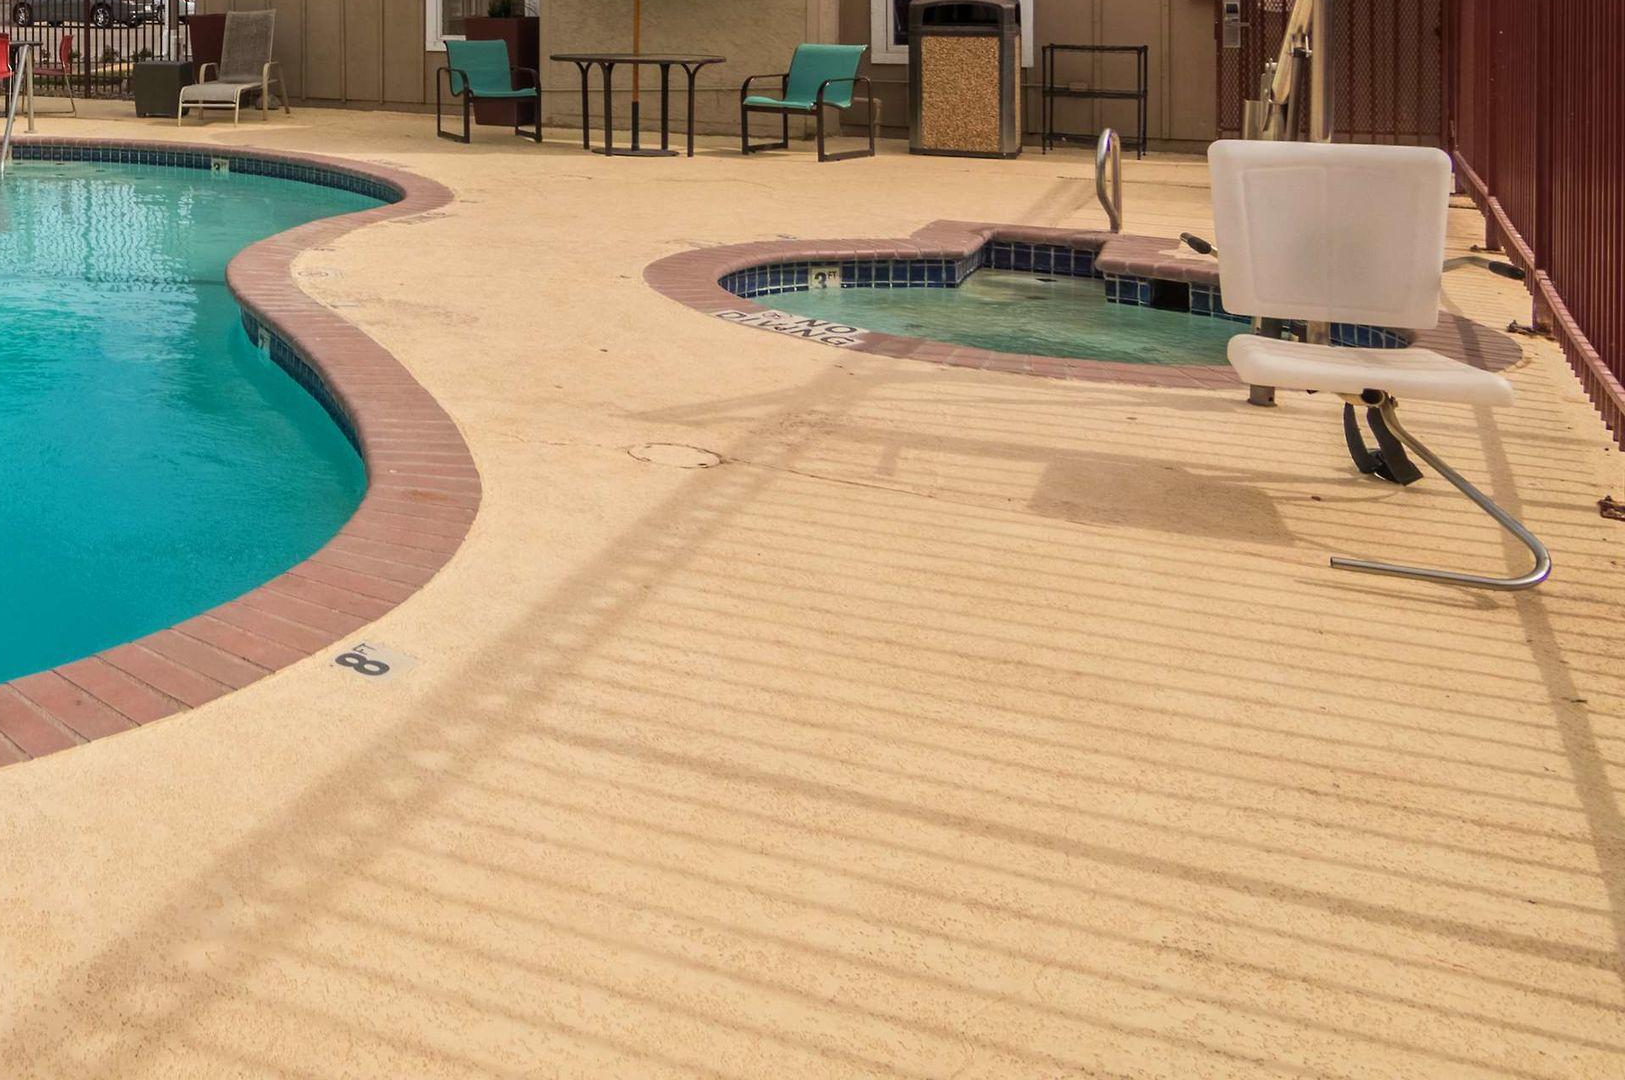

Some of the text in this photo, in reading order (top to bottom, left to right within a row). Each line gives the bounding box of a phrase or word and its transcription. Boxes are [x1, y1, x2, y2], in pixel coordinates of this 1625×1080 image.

[715, 311, 855, 346] DIVING
[794, 318, 857, 334] NO
[334, 652, 390, 676] 8
